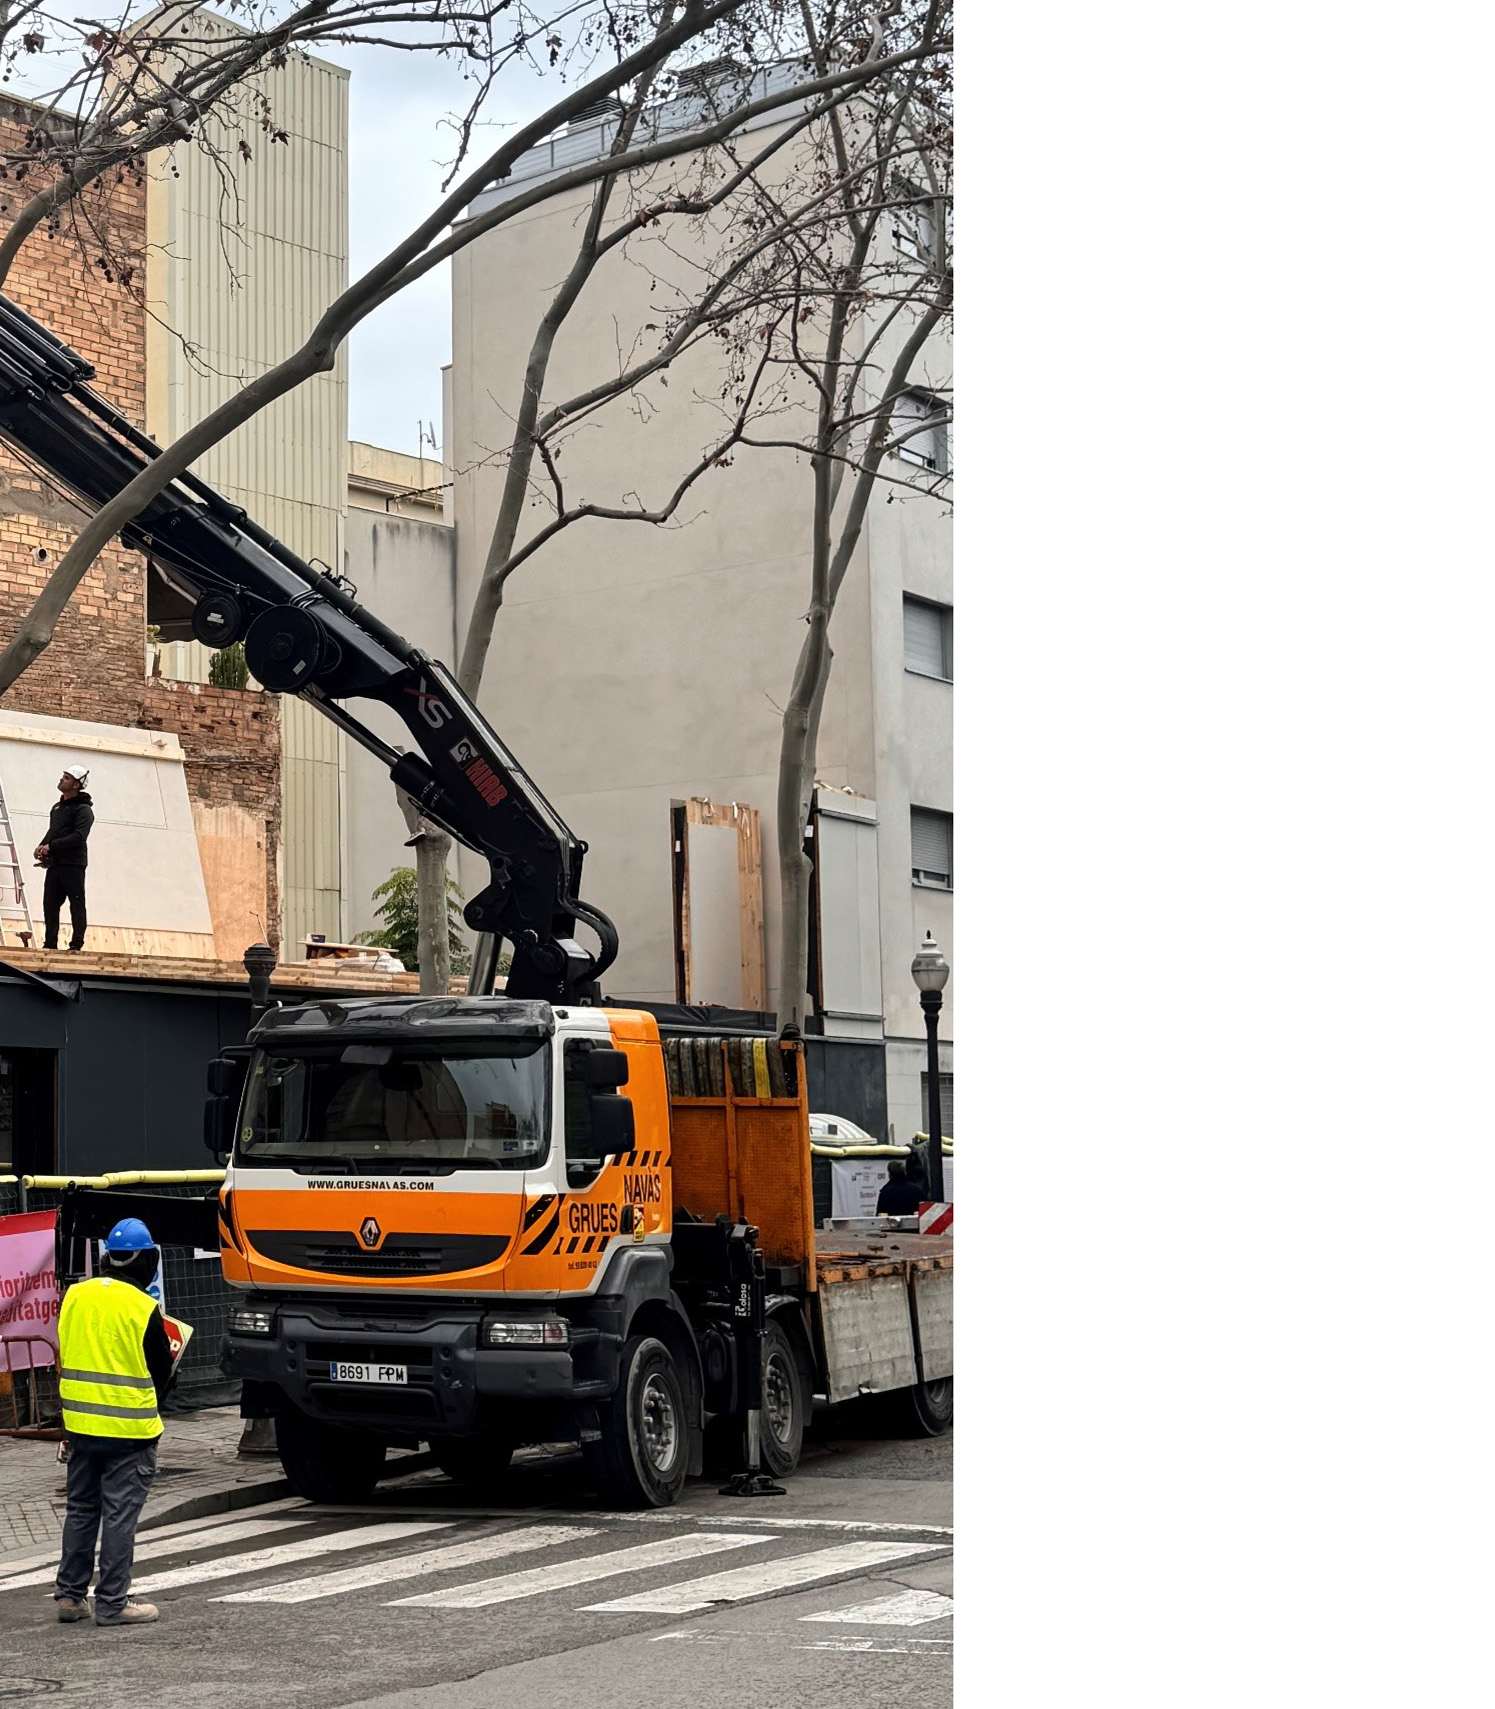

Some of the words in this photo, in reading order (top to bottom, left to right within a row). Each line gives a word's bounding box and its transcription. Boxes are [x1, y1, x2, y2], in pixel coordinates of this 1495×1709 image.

[404, 676, 453, 729] XS
[465, 758, 508, 807] HIAB
[623, 1166, 661, 1204] NAVÀS
[569, 1203, 618, 1233] GRUES
[339, 1364, 370, 1380] 8691
[378, 1366, 404, 1382] FPM
